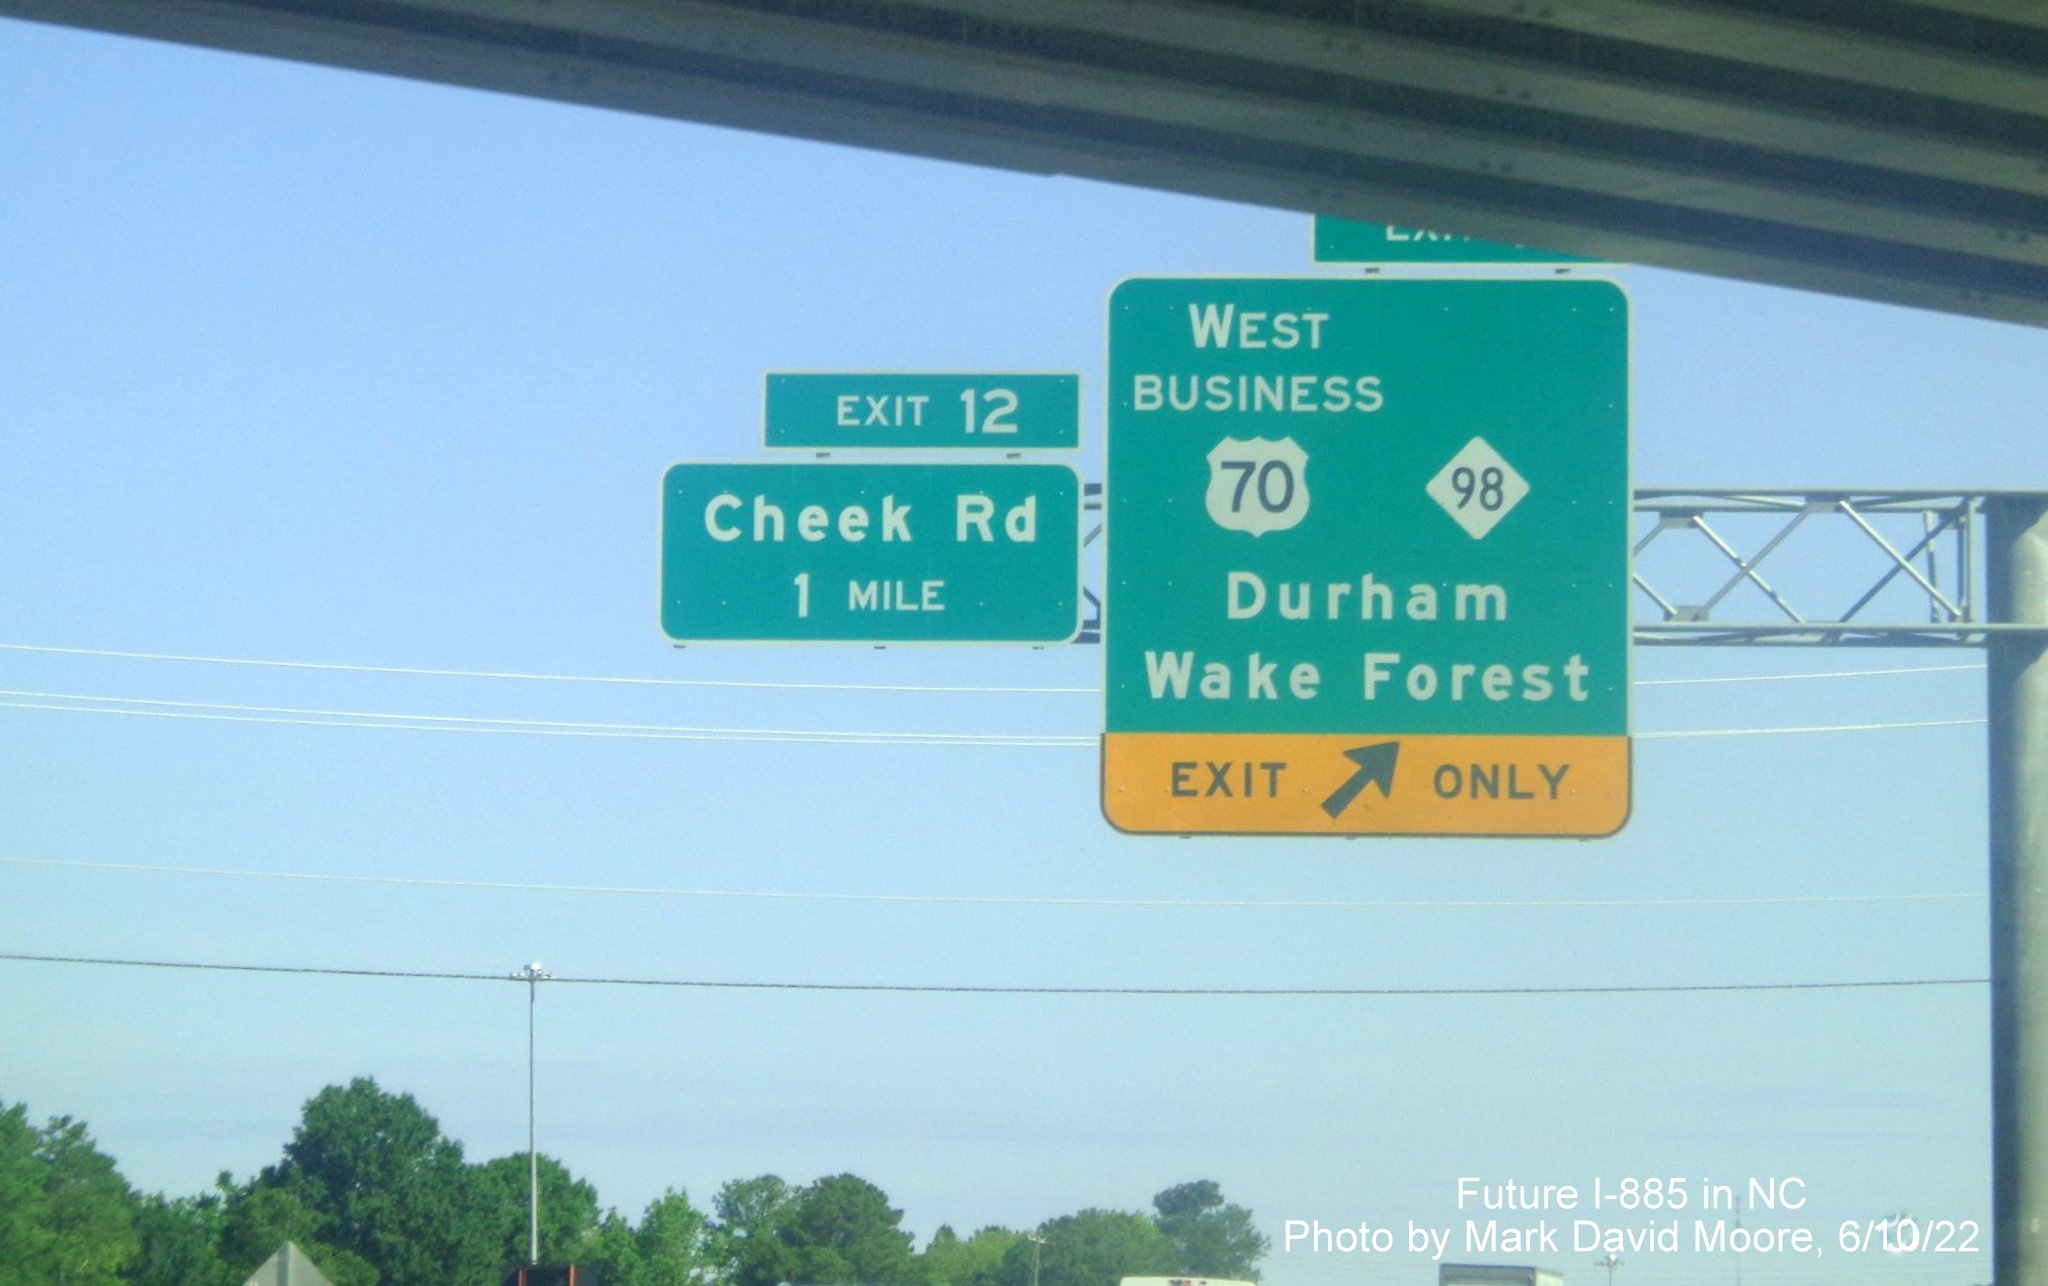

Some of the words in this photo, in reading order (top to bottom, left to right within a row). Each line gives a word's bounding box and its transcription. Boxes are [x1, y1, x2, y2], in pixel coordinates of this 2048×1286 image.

[838, 396, 929, 426] EXIT
[960, 389, 1018, 434] 12
[1134, 375, 1383, 412] BUSINESS
[1221, 460, 1295, 514] 70
[1452, 467, 1505, 512] 98
[705, 495, 912, 542] Cheek
[956, 495, 1037, 542] Rd
[794, 573, 809, 618] 1
[849, 581, 945, 611] MILE
[1228, 572, 1507, 621] Durham
[1146, 651, 1320, 700] Wake
[1365, 653, 1589, 702] Forest
[1172, 762, 1286, 798] EXIT
[1434, 765, 1570, 801] ONLY
